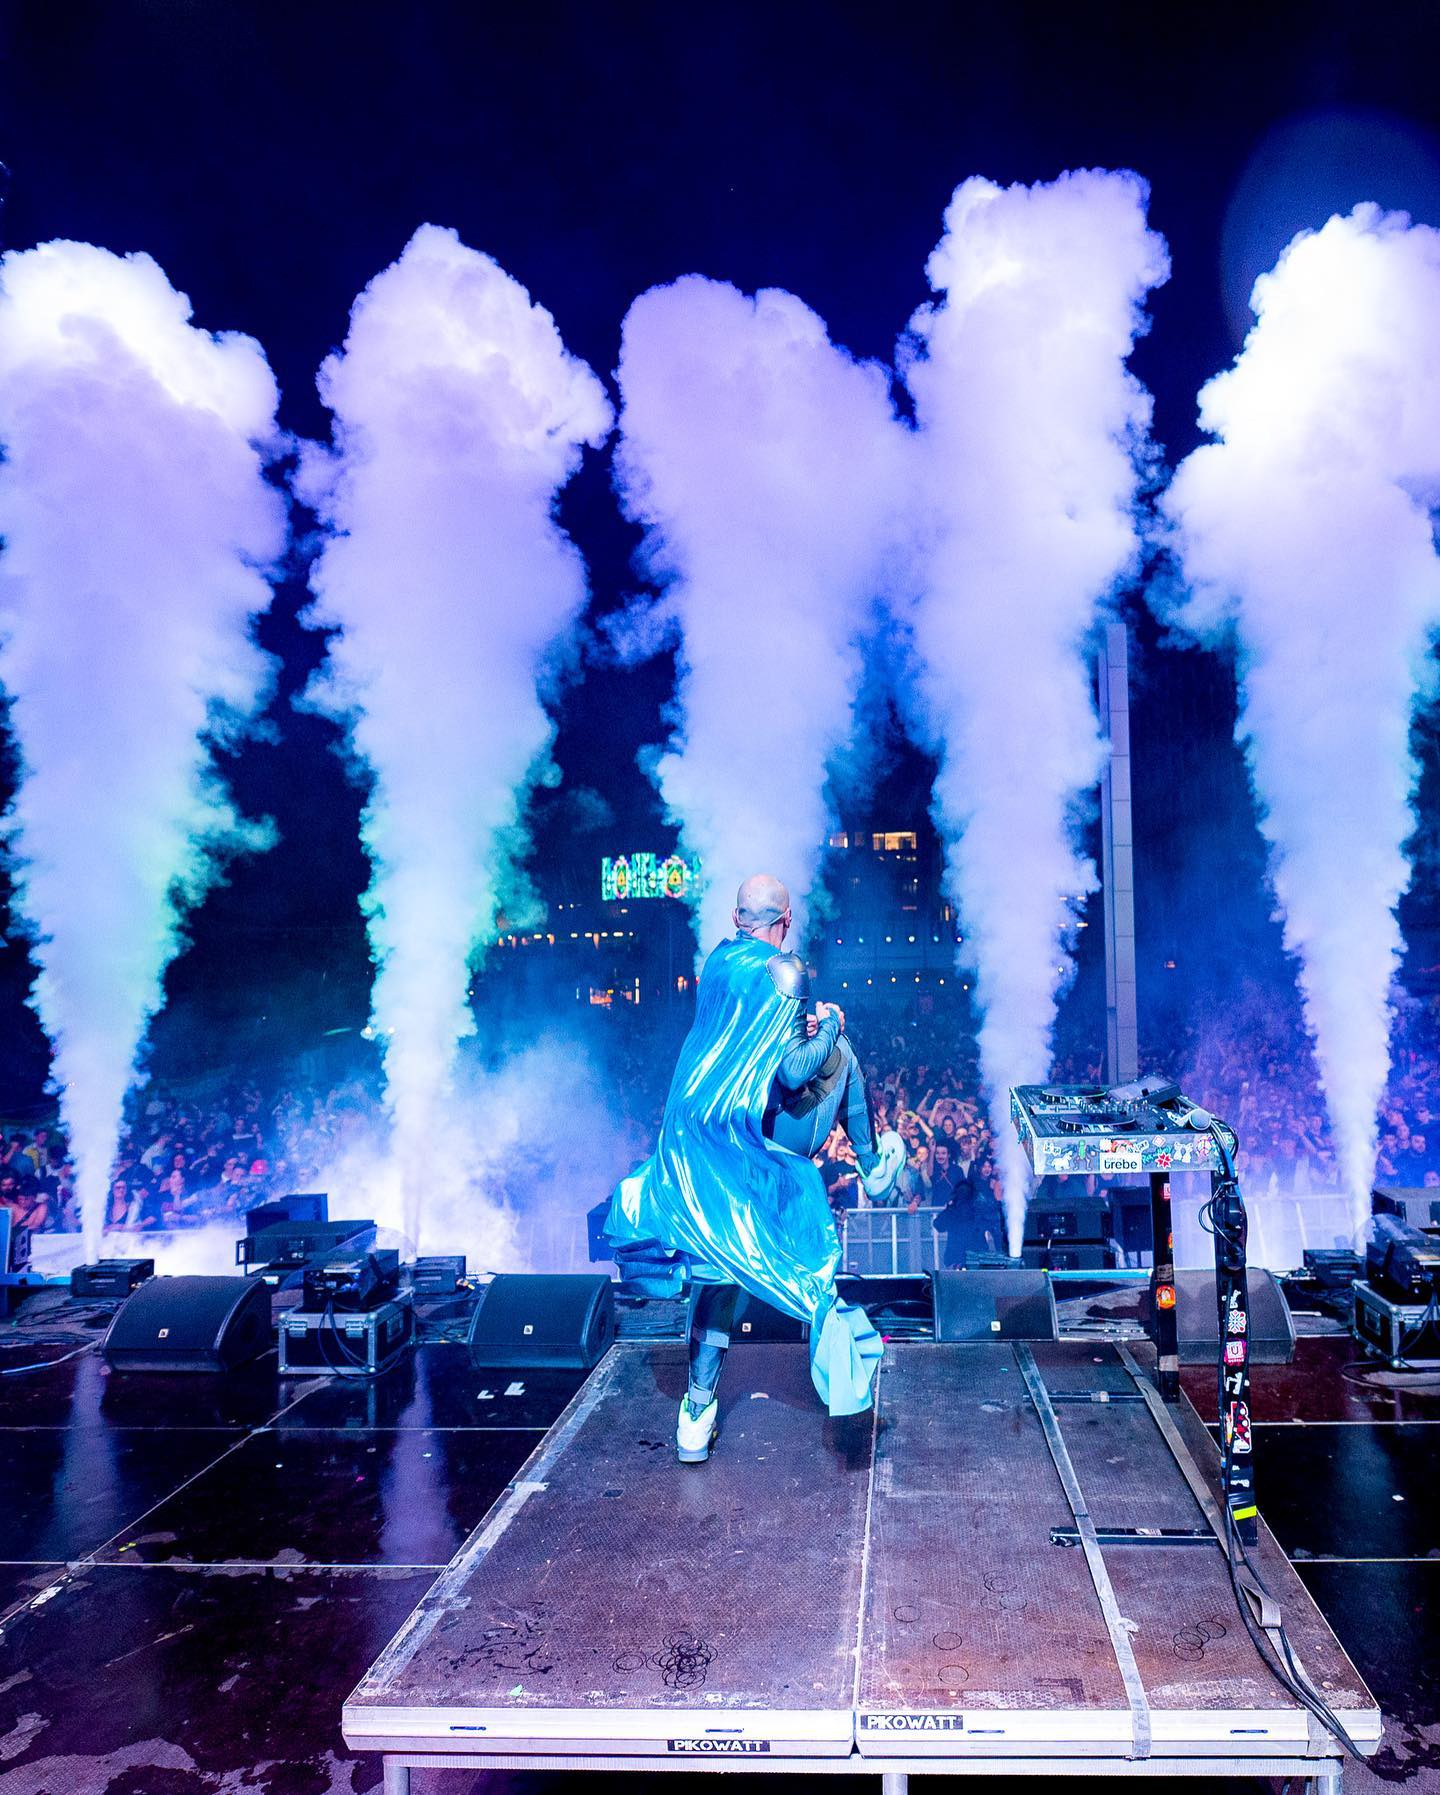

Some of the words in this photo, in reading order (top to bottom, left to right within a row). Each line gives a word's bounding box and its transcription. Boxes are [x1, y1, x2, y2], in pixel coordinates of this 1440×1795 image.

[1104, 1159, 1138, 1170] trebe
[867, 1715, 957, 1730] PIKOWATT
[673, 1740, 764, 1752] PIKOWATT
